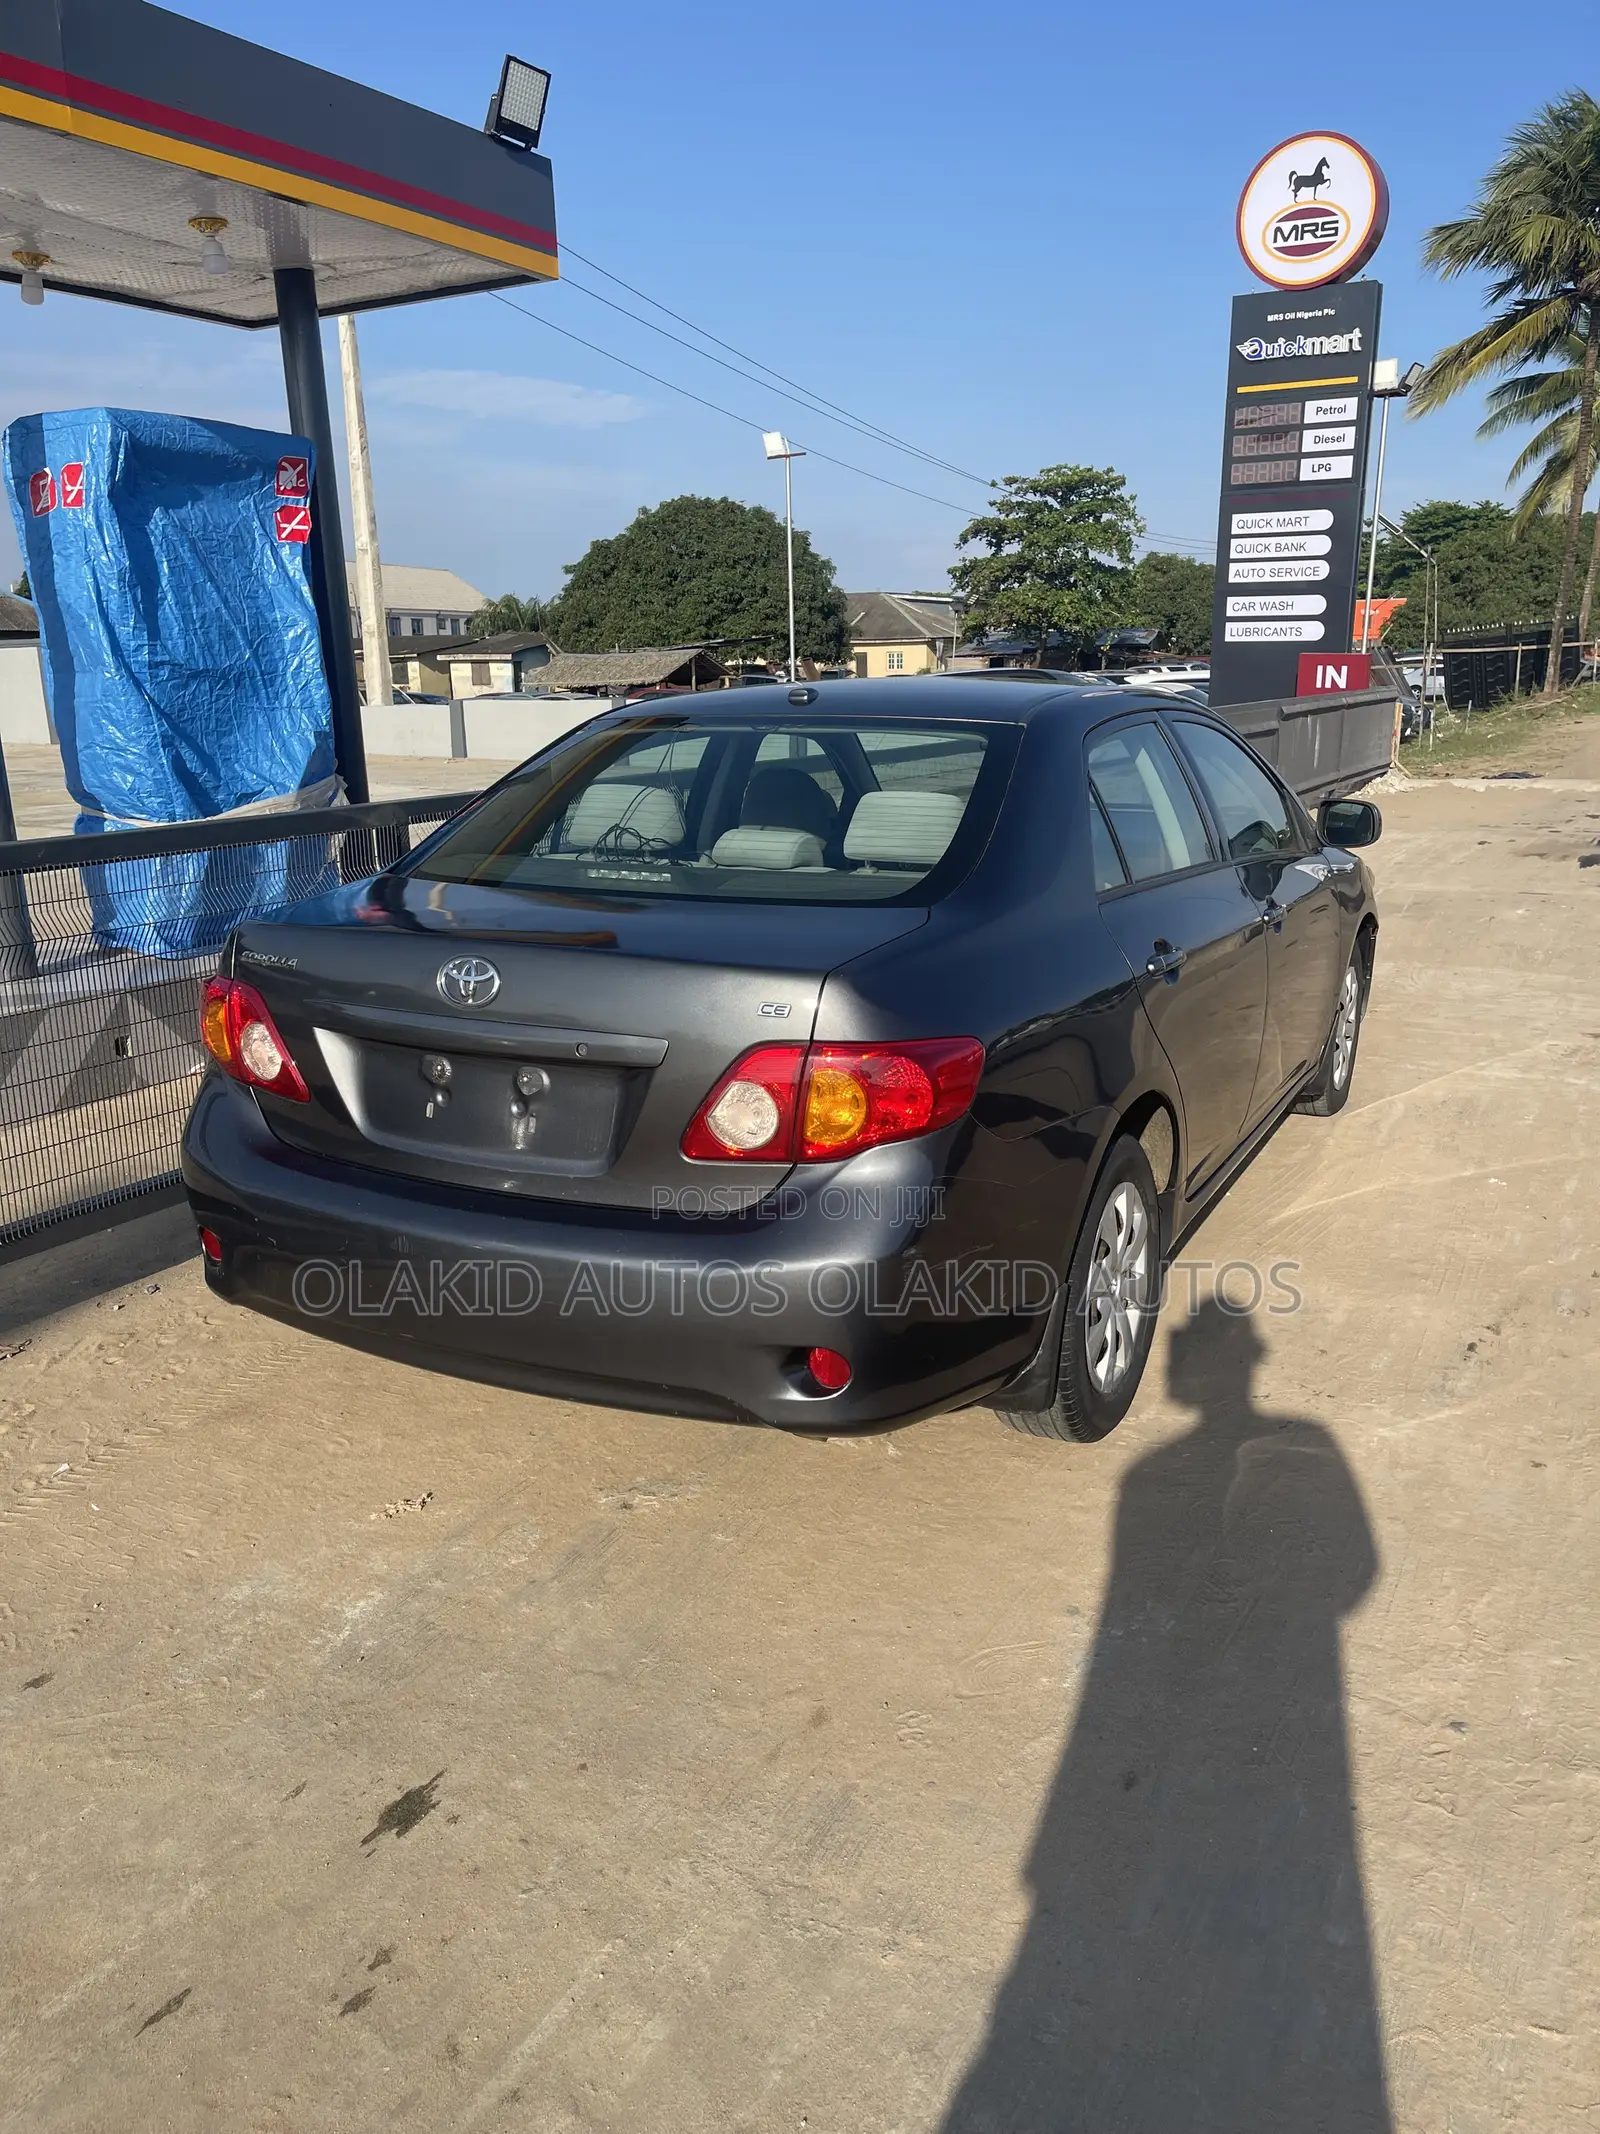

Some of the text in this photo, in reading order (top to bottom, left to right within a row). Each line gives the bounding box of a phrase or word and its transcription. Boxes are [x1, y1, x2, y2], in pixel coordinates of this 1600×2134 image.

[1272, 219, 1339, 244] MRS
[1267, 313, 1284, 322] MRS
[1285, 311, 1295, 320] Oil
[1296, 309, 1322, 320] Nigeria
[1236, 327, 1362, 361] Quickmart
[1315, 404, 1347, 416] Petrol
[1313, 433, 1346, 444] Diesel
[1311, 463, 1332, 473] LPG
[1236, 516, 1310, 530] QUICK MART
[1234, 541, 1307, 554] QUICK BANK
[1233, 566, 1320, 579] AUTO SERVICE
[1232, 600, 1294, 613] CAR WASH
[1229, 626, 1303, 638] LUBRICANTS
[1315, 665, 1348, 689] IN
[760, 1004, 788, 1016] CE
